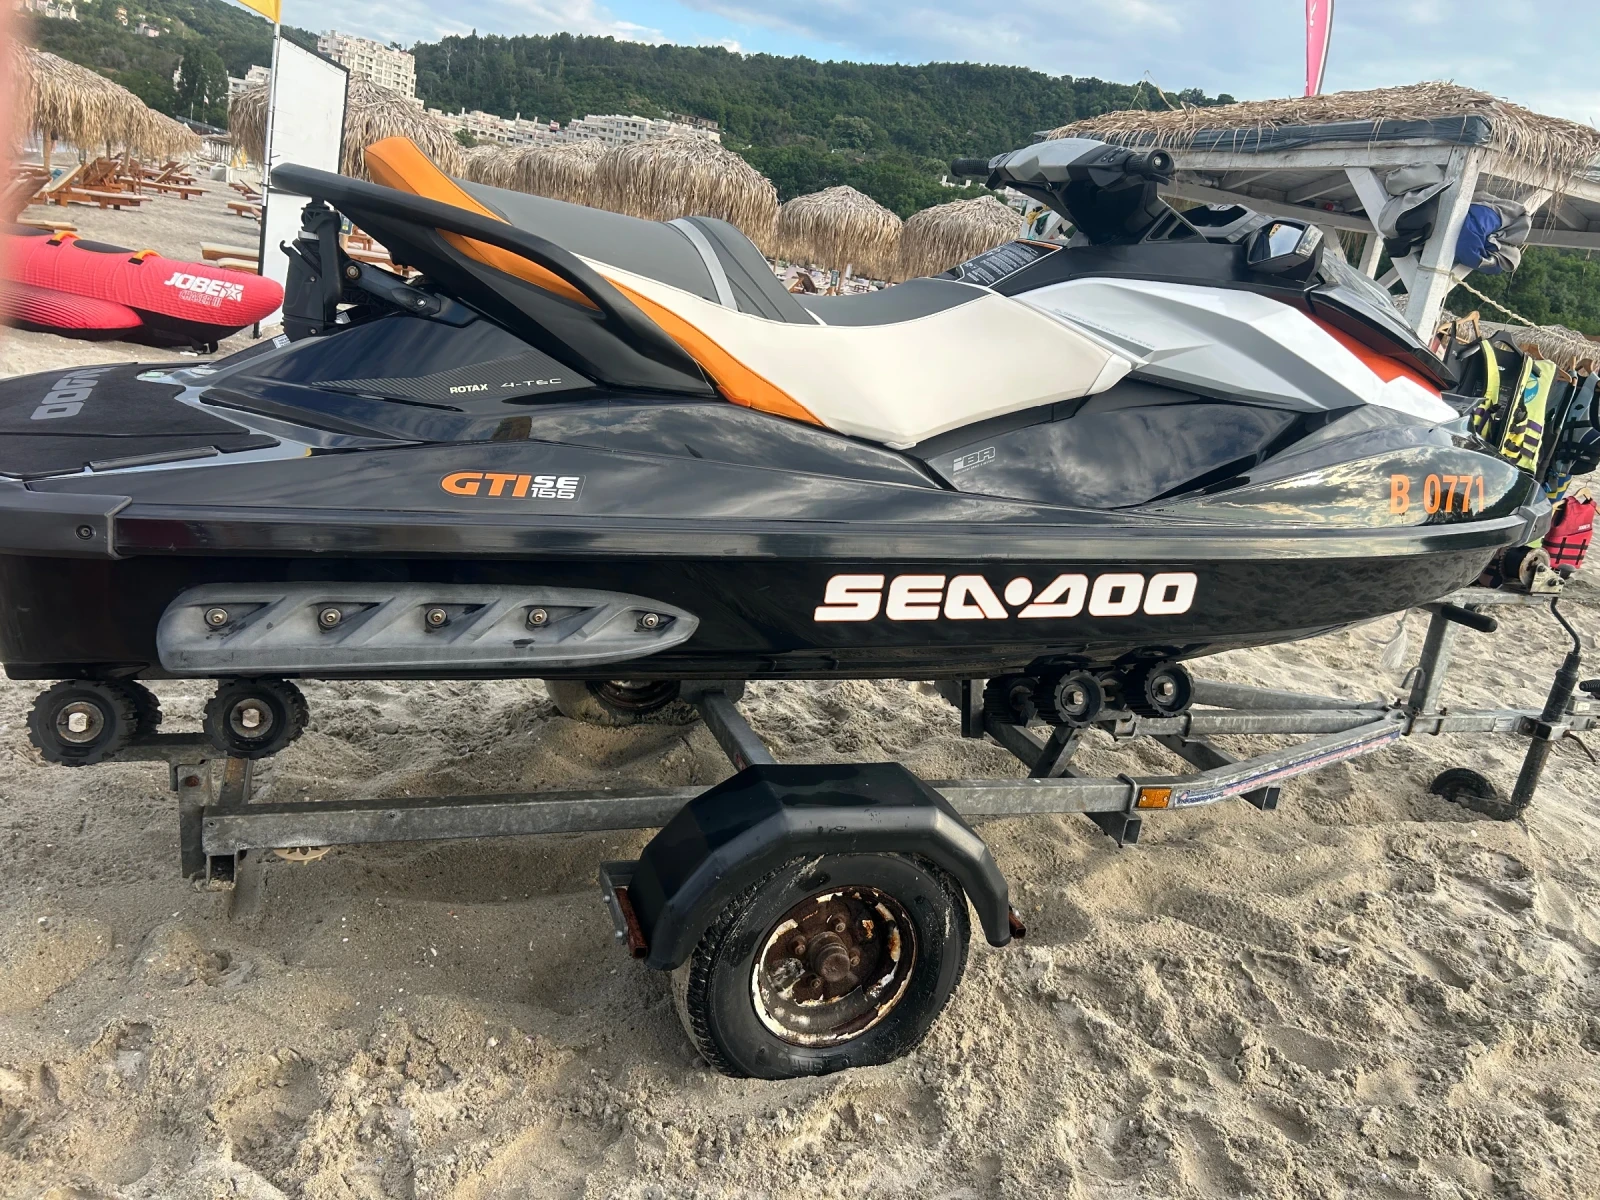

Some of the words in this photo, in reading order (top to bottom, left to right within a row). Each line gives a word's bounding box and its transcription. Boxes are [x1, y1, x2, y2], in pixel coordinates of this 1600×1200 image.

[164, 271, 224, 297] JOBE
[179, 290, 213, 306] CHASER
[212, 296, 223, 307] III
[449, 383, 488, 394] ROTAX
[500, 378, 562, 388] 4-TEC
[441, 472, 532, 497] GTI
[532, 475, 580, 490] SE
[531, 487, 576, 499] 155
[1390, 473, 1410, 514] B
[1423, 473, 1485, 514] 0771
